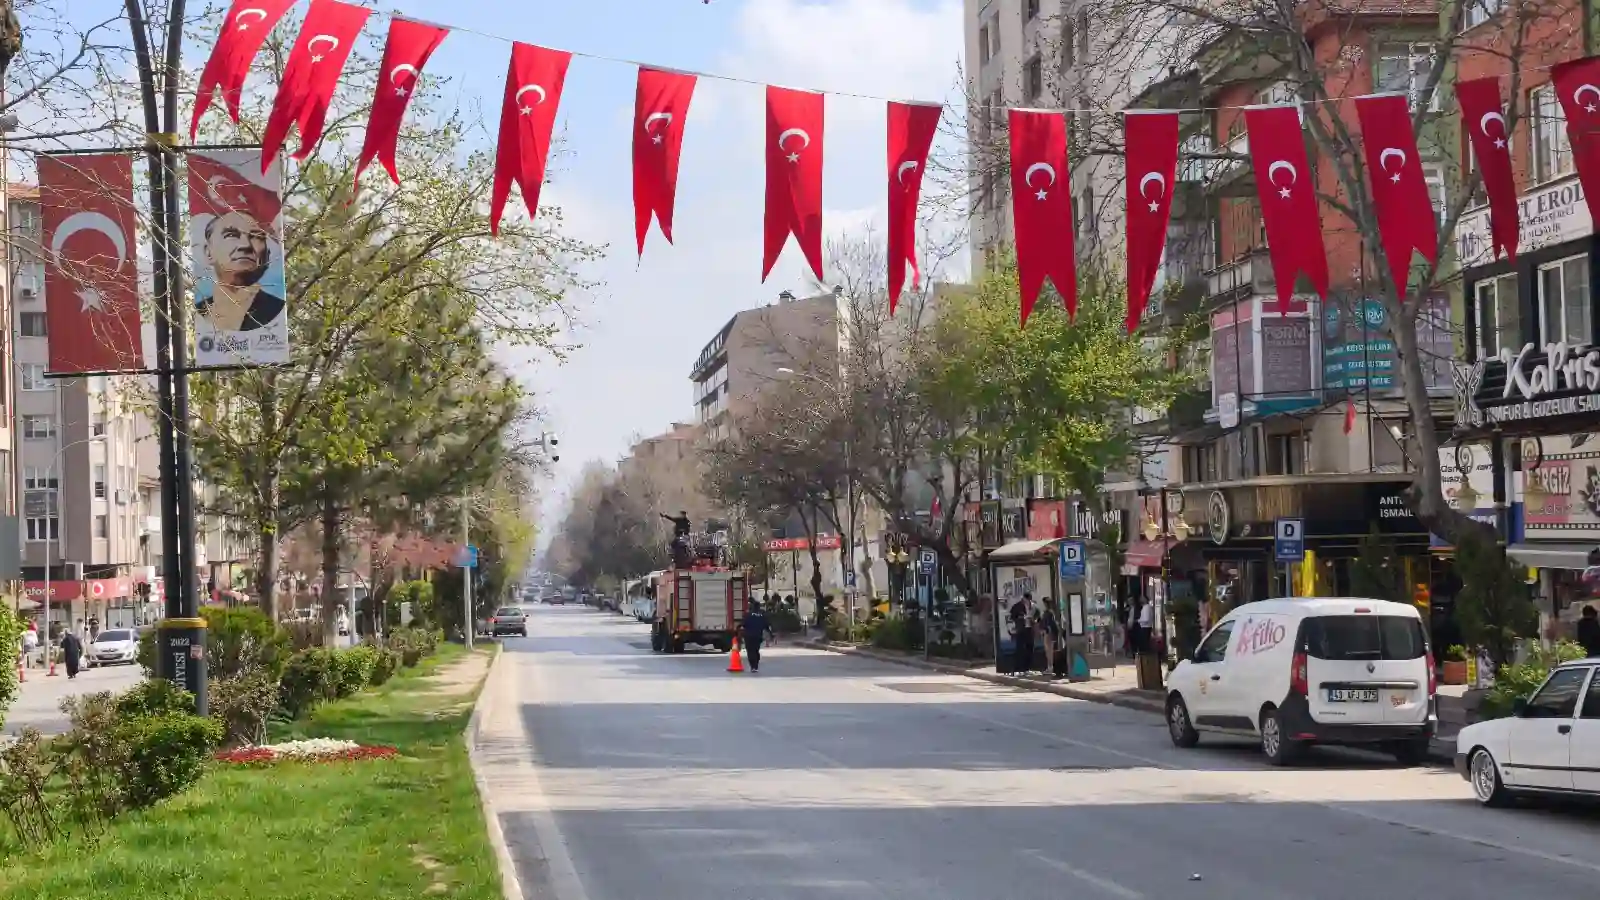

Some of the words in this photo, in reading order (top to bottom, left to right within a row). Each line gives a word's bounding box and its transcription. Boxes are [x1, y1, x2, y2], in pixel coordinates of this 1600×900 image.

[1537, 182, 1584, 215] EROL
[1284, 523, 1295, 538] D
[1067, 547, 1077, 560] D
[170, 637, 190, 647] 2022
